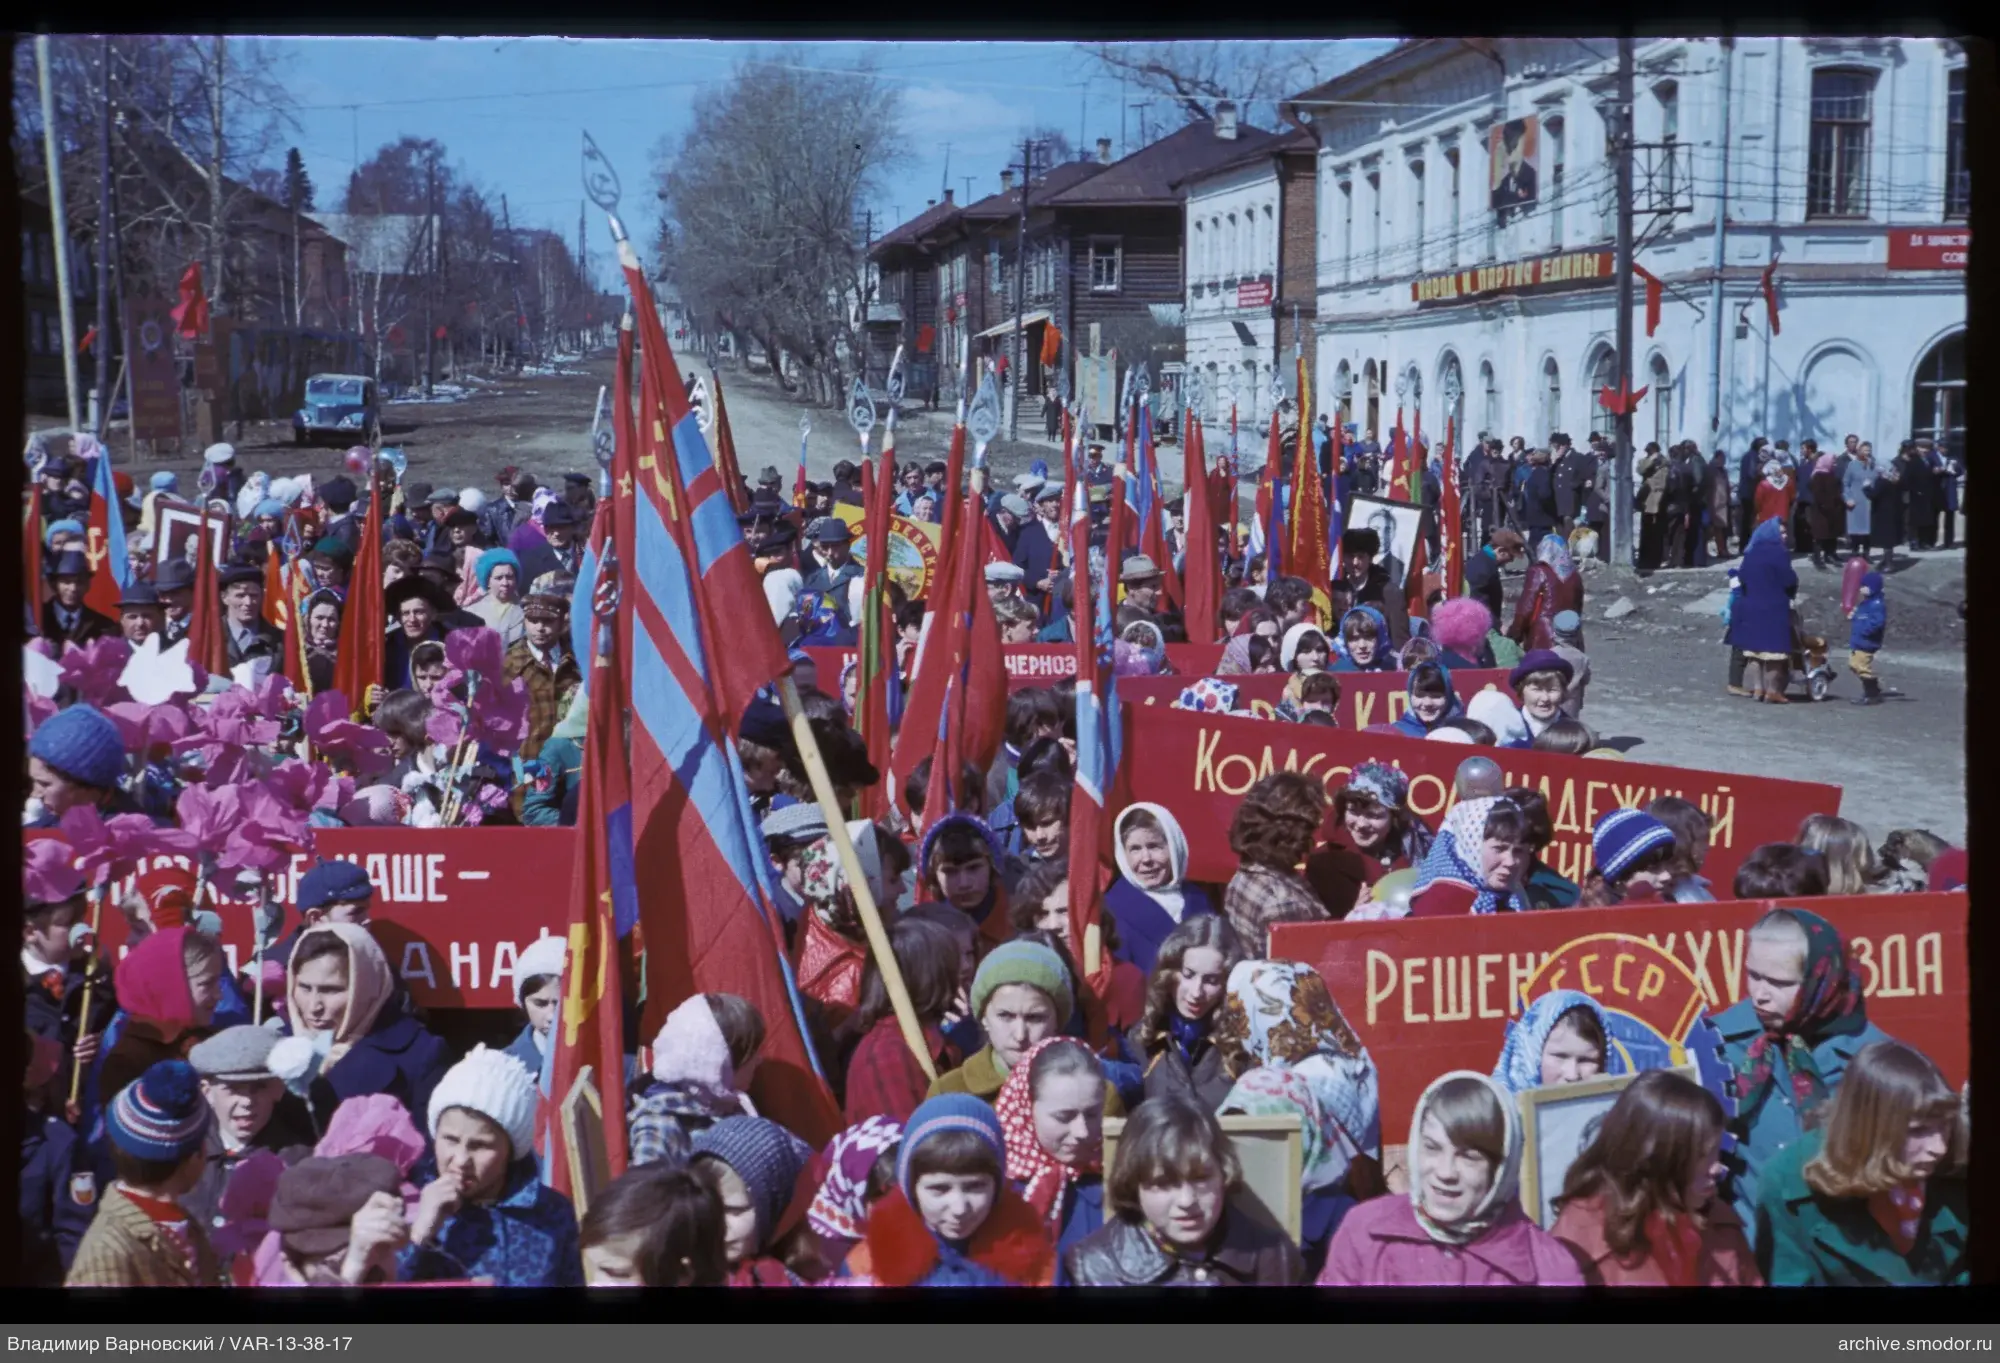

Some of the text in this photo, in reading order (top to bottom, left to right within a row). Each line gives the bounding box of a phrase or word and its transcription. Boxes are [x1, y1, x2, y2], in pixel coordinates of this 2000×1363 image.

[1418, 273, 1458, 300] НАРОД
[1477, 261, 1533, 291] ПАРТИЯ
[1540, 252, 1600, 283] ЕДИНЫ
[335, 853, 448, 902] АШЕ
[1365, 950, 1549, 1025] РЕШЕН
[1851, 932, 1943, 998] ЗДА
